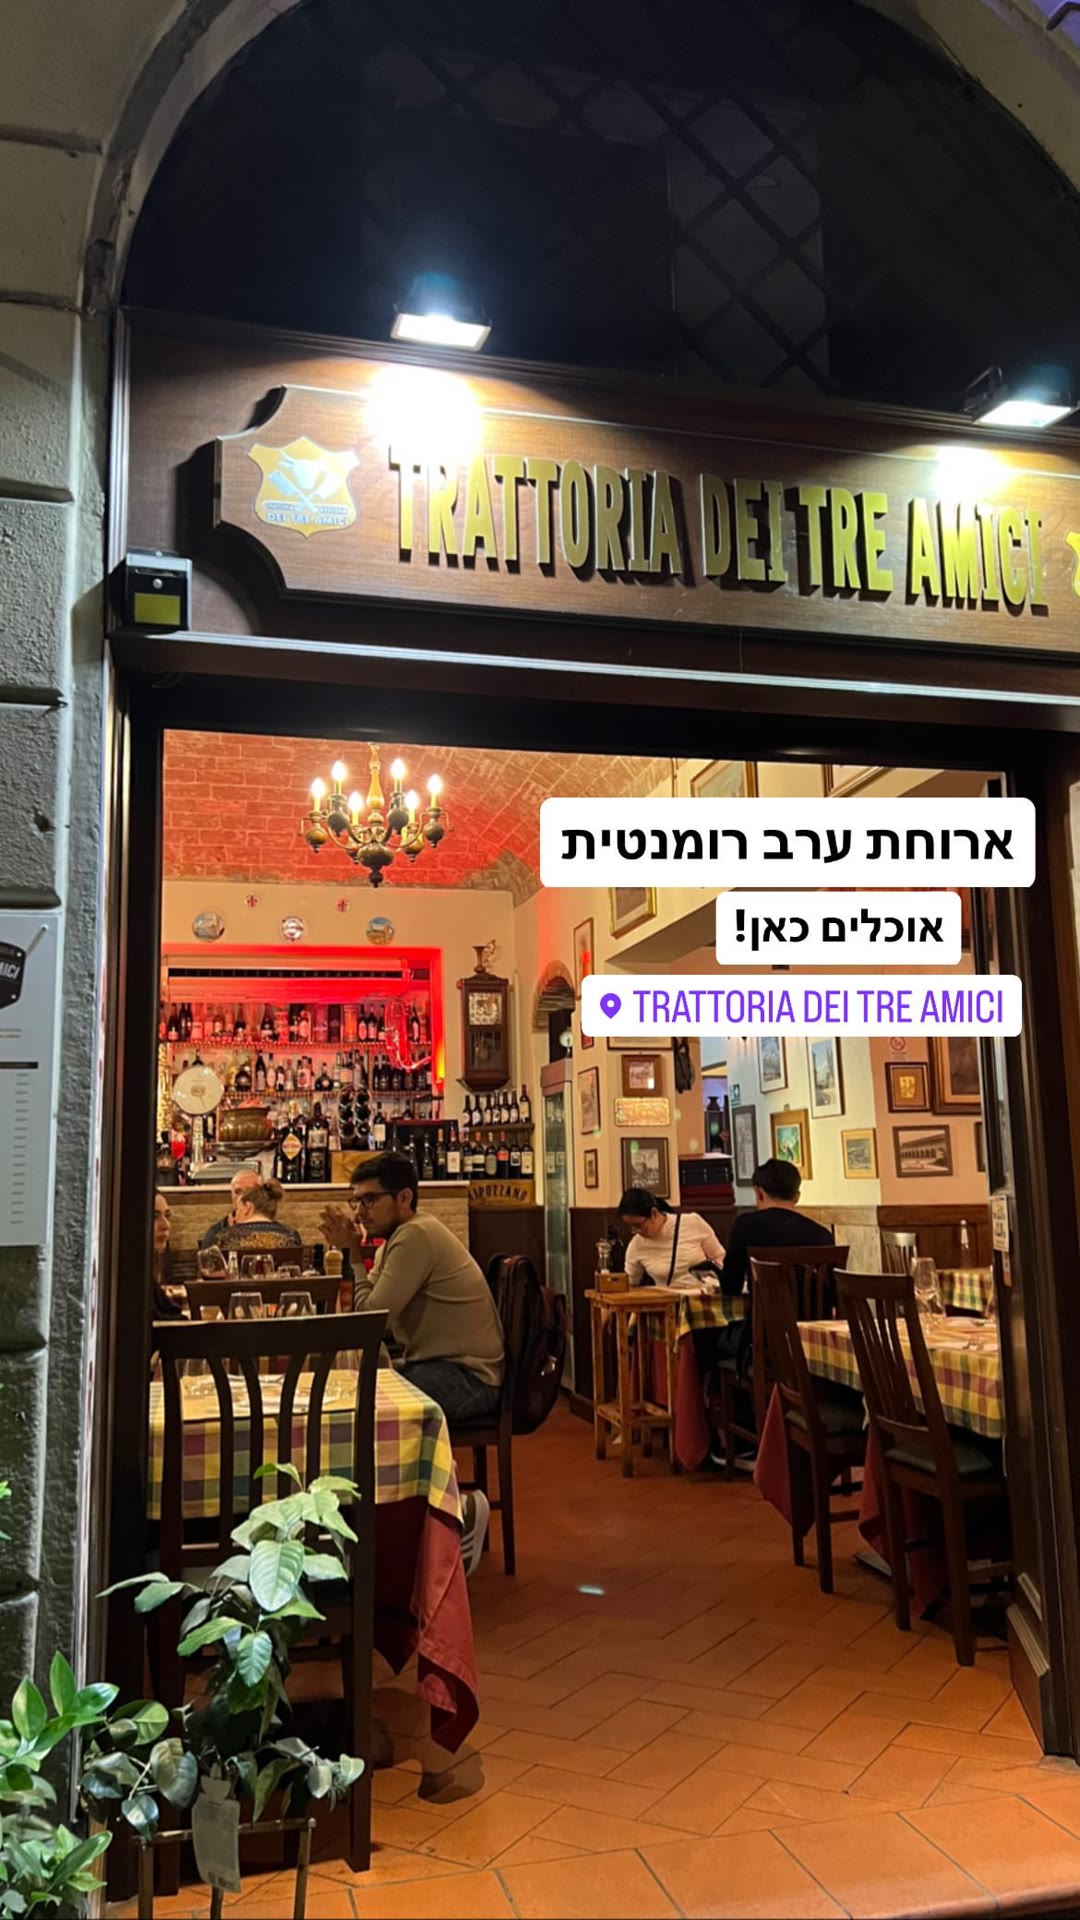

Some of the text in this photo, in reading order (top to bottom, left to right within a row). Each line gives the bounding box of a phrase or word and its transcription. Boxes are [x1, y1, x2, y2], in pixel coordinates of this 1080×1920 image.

[390, 447, 1049, 606] TRATTORIA DEI TRE AMICI
